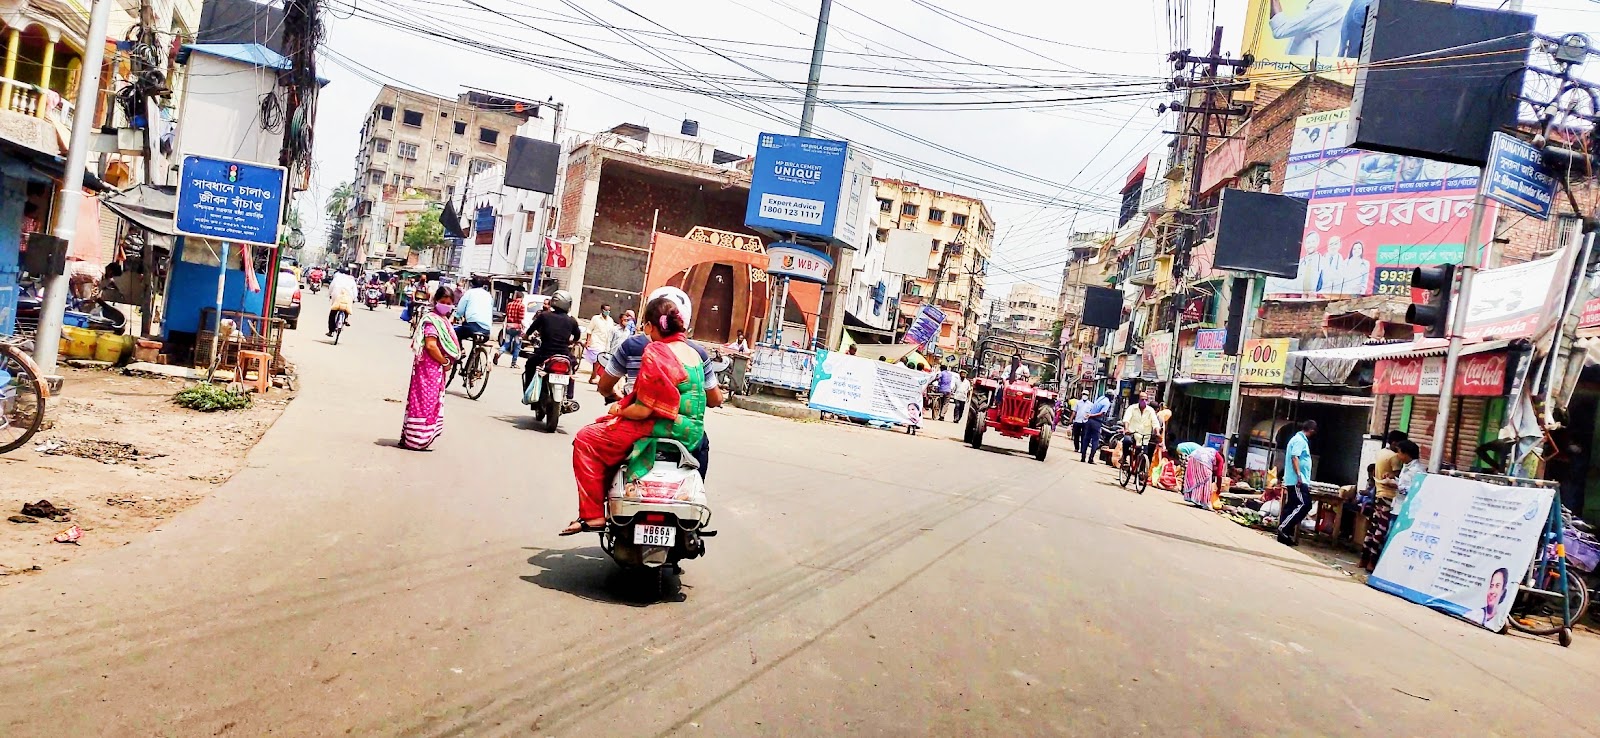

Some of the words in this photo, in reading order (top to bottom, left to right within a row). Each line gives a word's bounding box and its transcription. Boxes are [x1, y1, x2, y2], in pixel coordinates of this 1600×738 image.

[1500, 139, 1529, 160] SUNAYNA
[1529, 151, 1542, 164] EYE
[774, 166, 822, 180] UNIQUE
[800, 163, 822, 171] CEMENT
[192, 179, 235, 194] সাবধানে
[239, 186, 271, 199] চালাও
[1502, 173, 1519, 189] Shyam
[1519, 181, 1536, 196] Sundar
[199, 191, 228, 206] জীবন
[231, 196, 263, 211] বাঁচাও
[768, 198, 792, 208] Expert
[793, 202, 817, 210] Advice
[763, 205, 782, 214] 1800
[785, 208, 798, 216] 123
[801, 211, 820, 219] 1117
[1305, 202, 1348, 231] স্থা
[1356, 195, 1477, 227] হারবাল
[798, 258, 819, 271] W.B.P
[1483, 320, 1527, 337] Honda
[1198, 330, 1225, 349] MOBILE
[1248, 345, 1277, 363] FOOD
[1240, 368, 1281, 378] EXPRESS
[1421, 377, 1439, 386] SWEETS
[643, 525, 670, 536] WB66A
